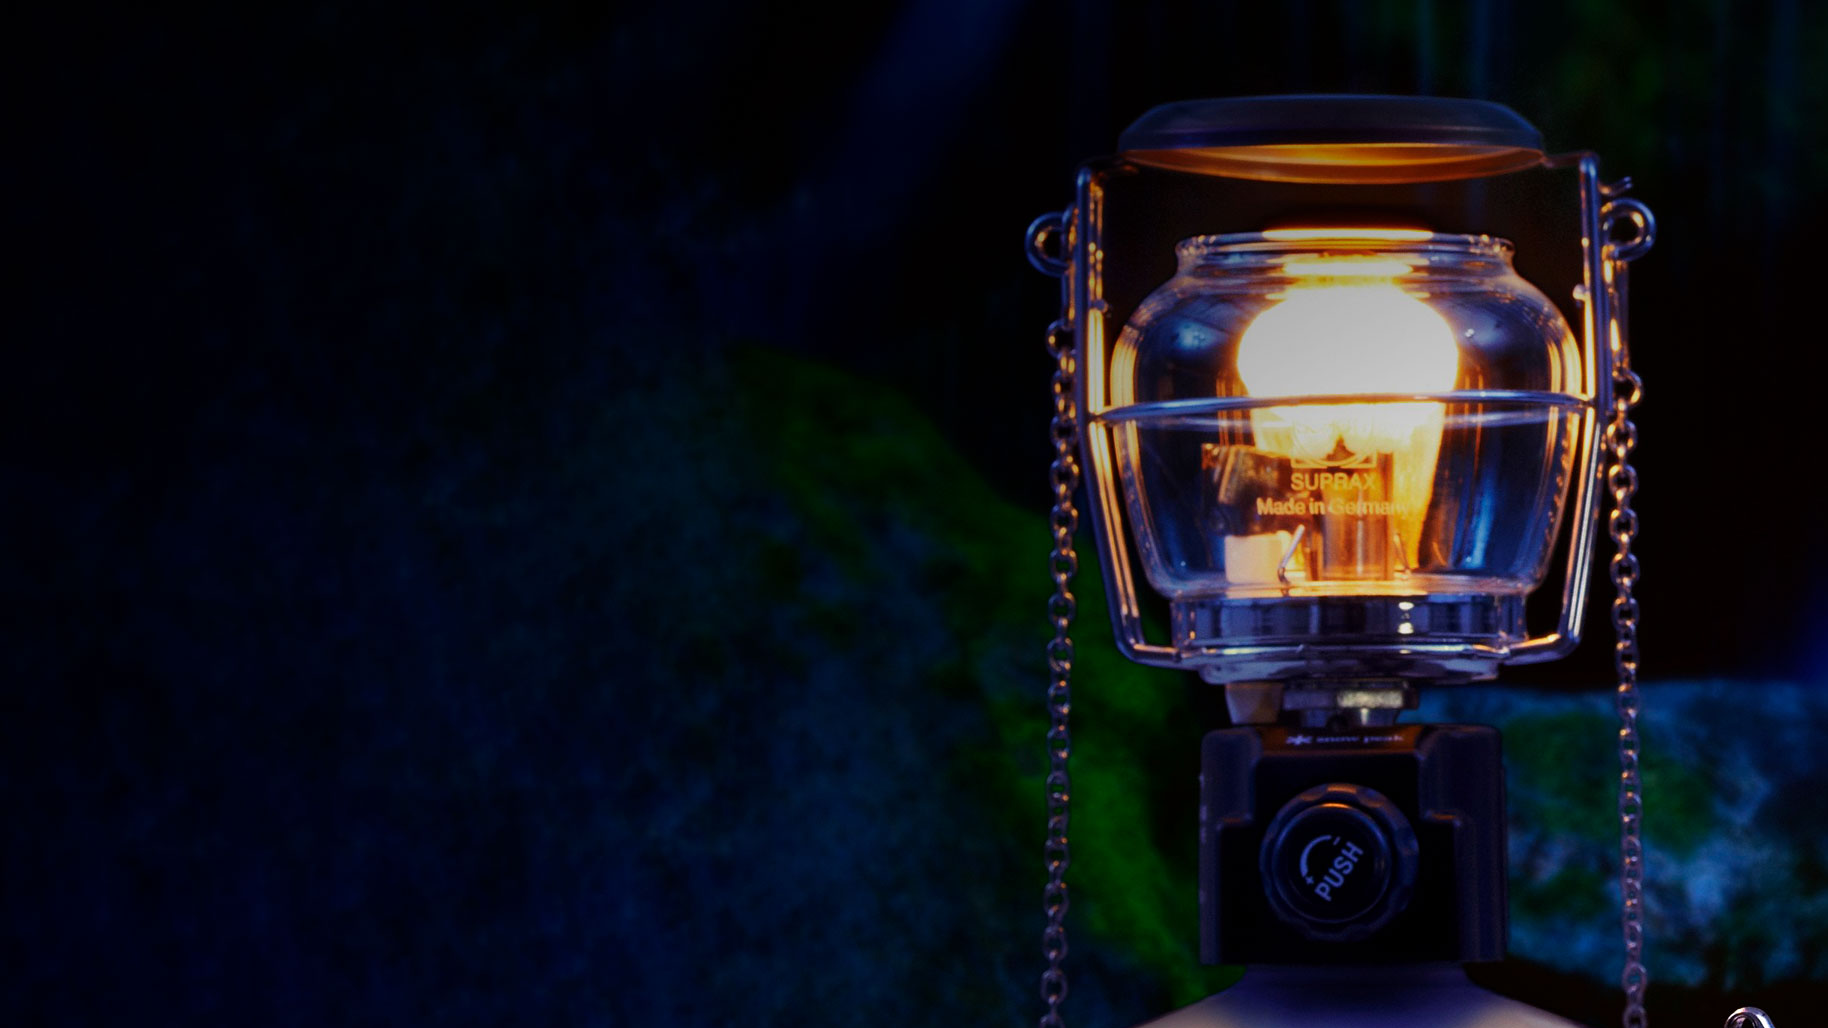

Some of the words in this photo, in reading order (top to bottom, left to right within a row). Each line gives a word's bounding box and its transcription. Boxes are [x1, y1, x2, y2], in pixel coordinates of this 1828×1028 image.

[1290, 472, 1378, 491] SUPRAX
[1256, 497, 1305, 516] Made
[1308, 497, 1326, 516] in
[1313, 840, 1365, 903] PUSH
